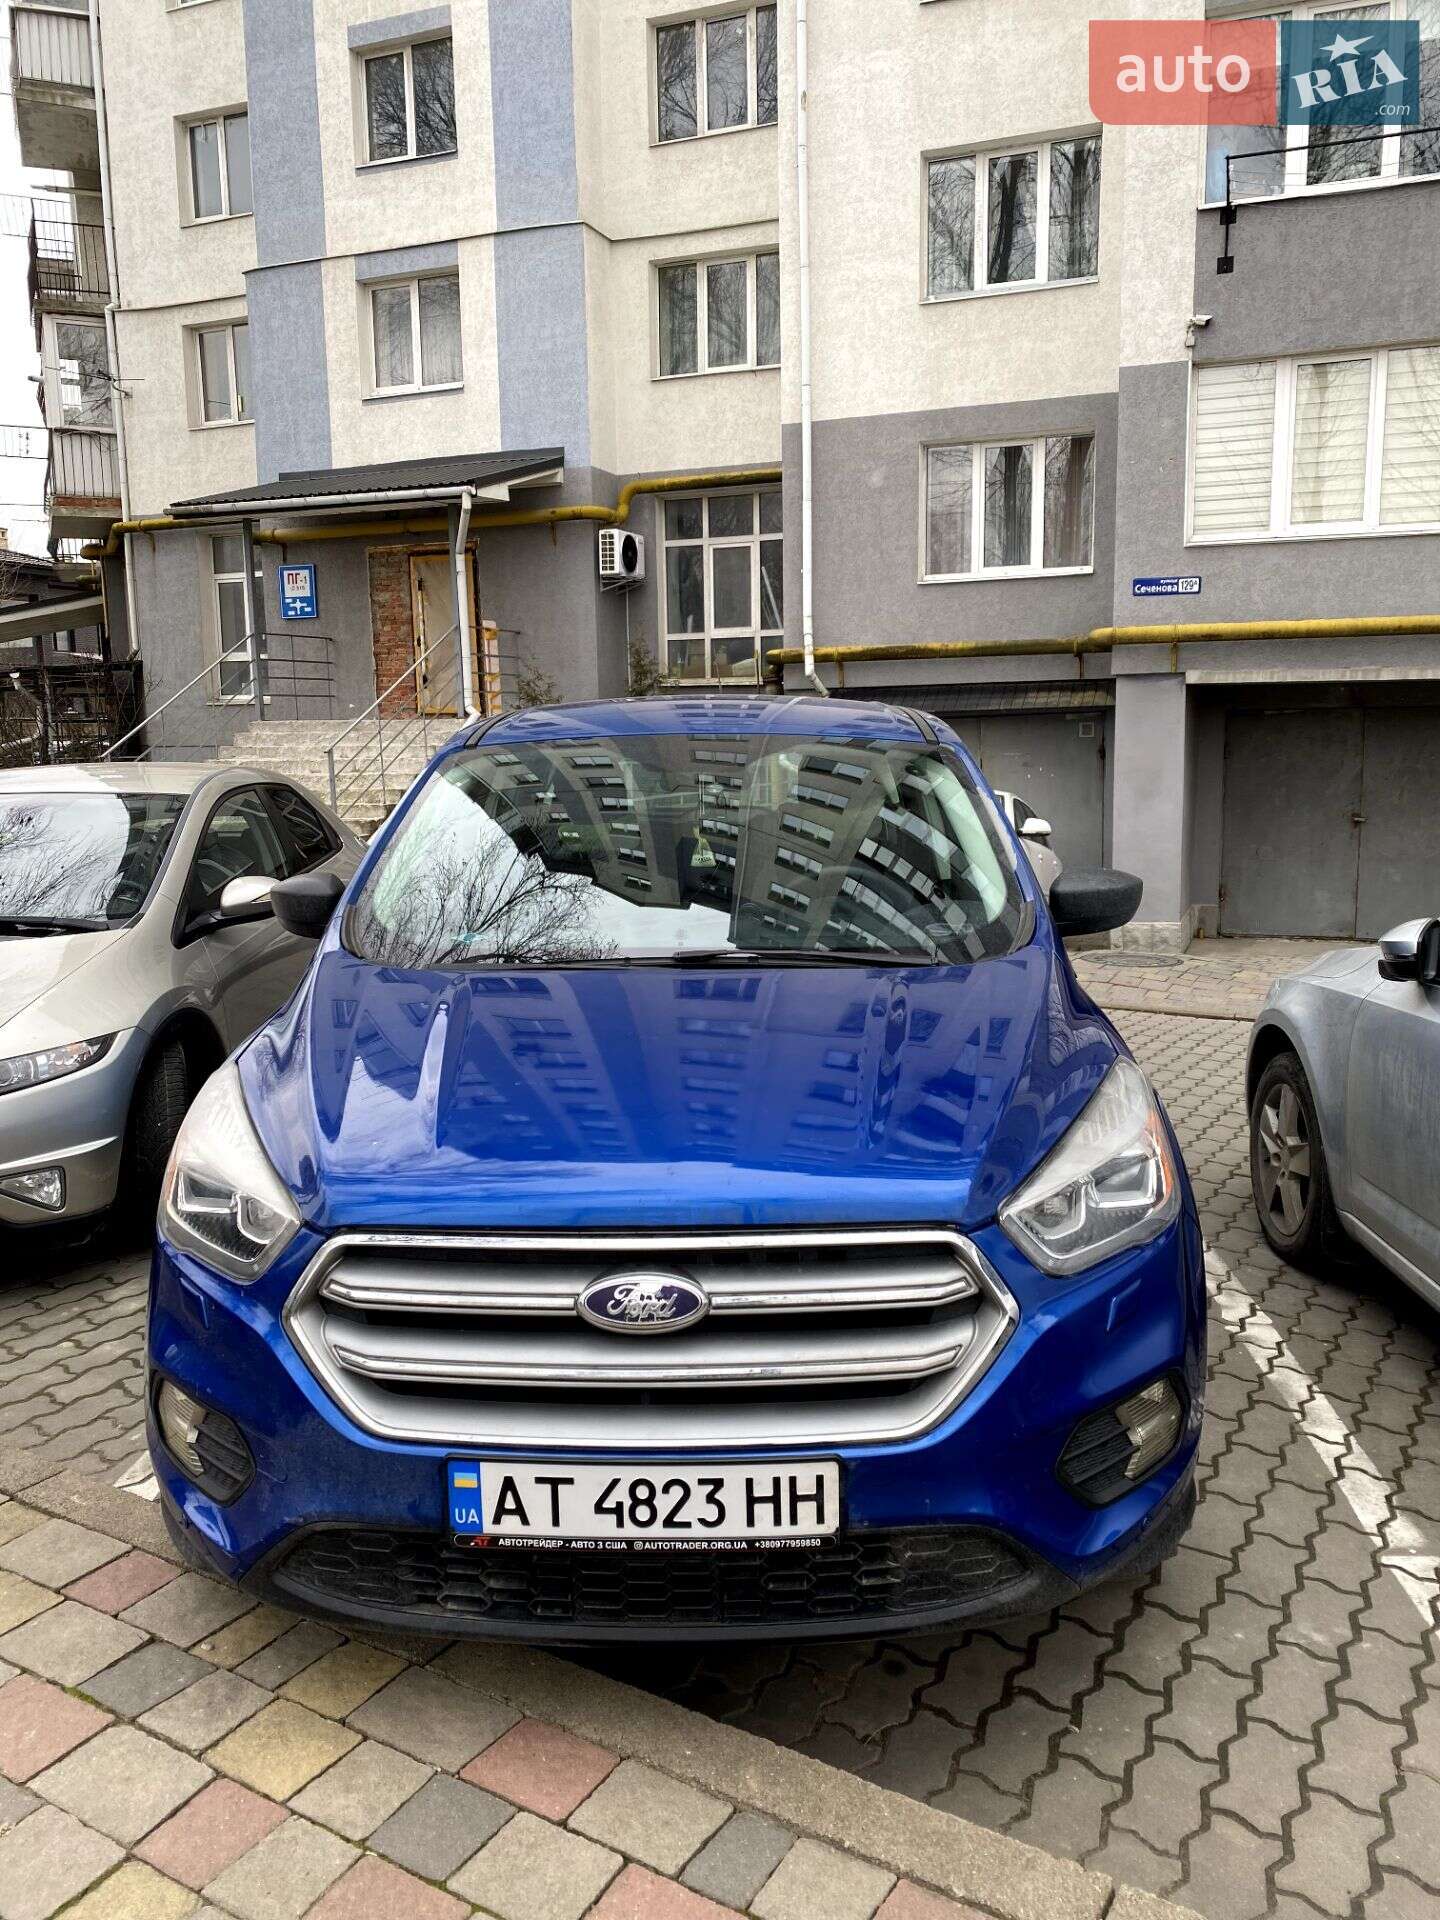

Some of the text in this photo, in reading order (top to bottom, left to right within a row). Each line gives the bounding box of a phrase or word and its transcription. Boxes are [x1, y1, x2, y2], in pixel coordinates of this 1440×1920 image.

[1134, 584, 1178, 593] Сеченова
[606, 1284, 678, 1319] Ford
[491, 1474, 826, 1529] AT 4823 HH
[454, 1508, 480, 1524] UA
[498, 1537, 564, 1548] АВТОТРЕЙДЕР
[570, 1541, 595, 1549] АВТО
[605, 1541, 627, 1549] США
[754, 1538, 821, 1549] +380977959850
